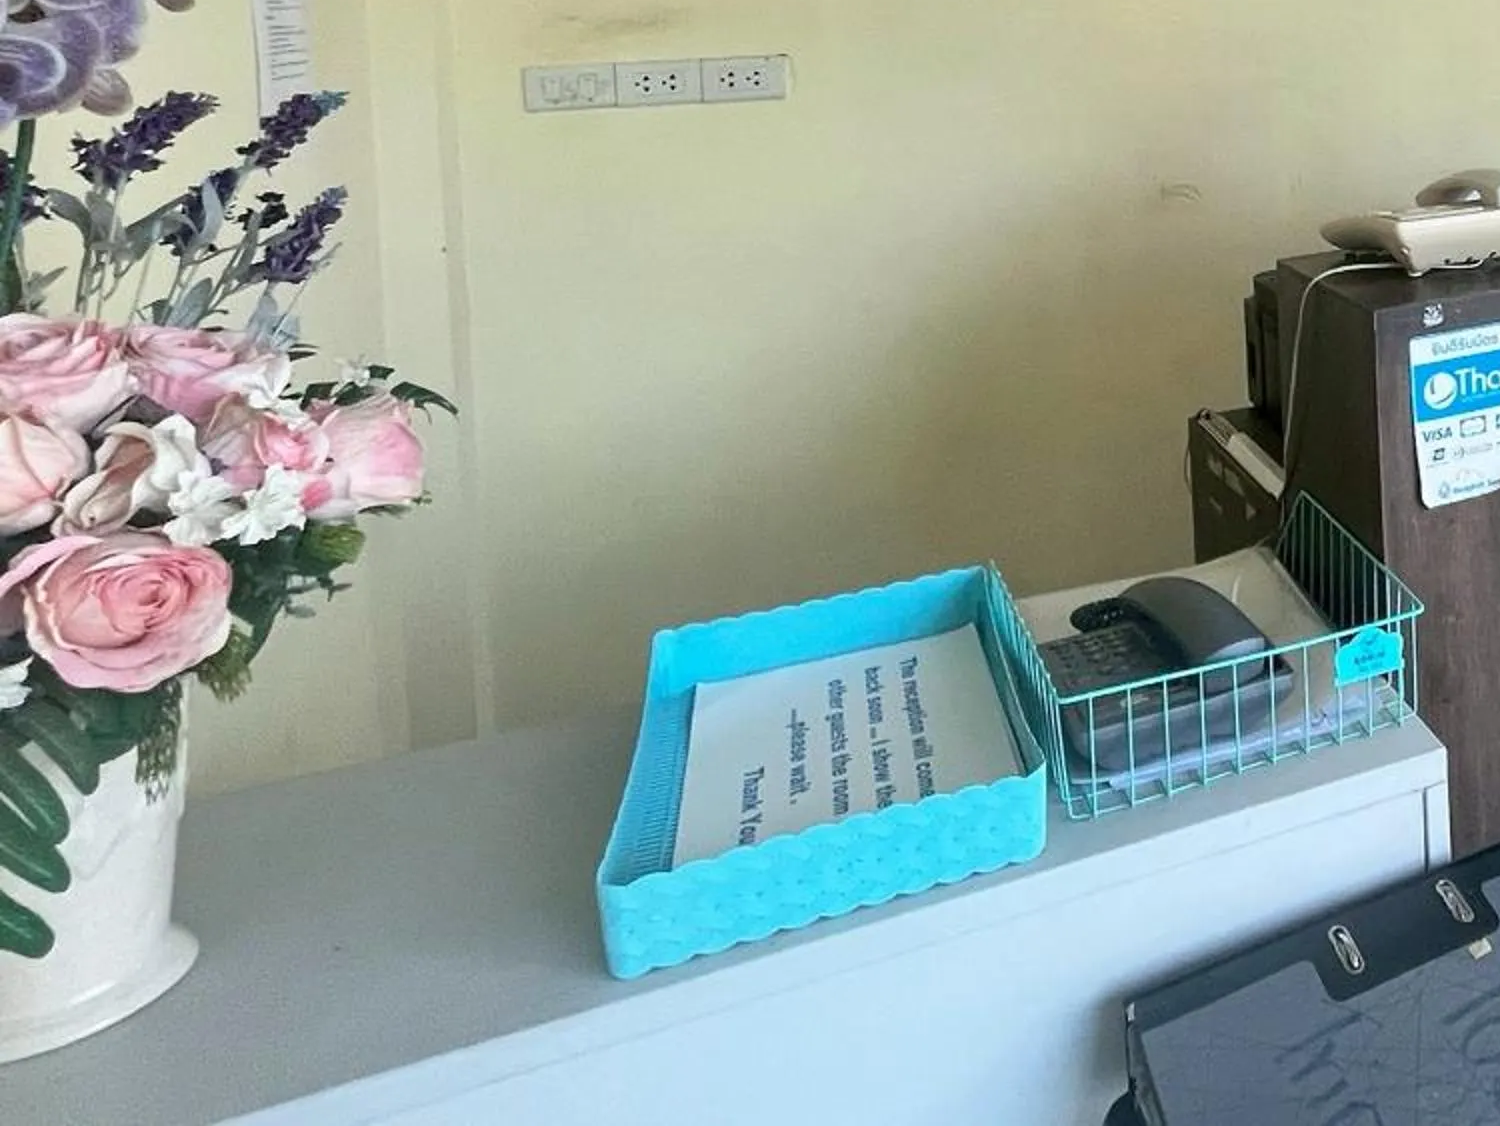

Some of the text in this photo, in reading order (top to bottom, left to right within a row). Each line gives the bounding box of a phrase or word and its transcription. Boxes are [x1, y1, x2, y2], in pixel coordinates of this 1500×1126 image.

[1421, 425, 1453, 443] VISA
[864, 665, 887, 695] back
[899, 654, 918, 679] The
[867, 695, 884, 724] soon
[902, 679, 927, 735] reception
[824, 678, 853, 817] other guests the room
[912, 735, 934, 760] will
[872, 747, 893, 784] show
[741, 765, 765, 814] Thank
